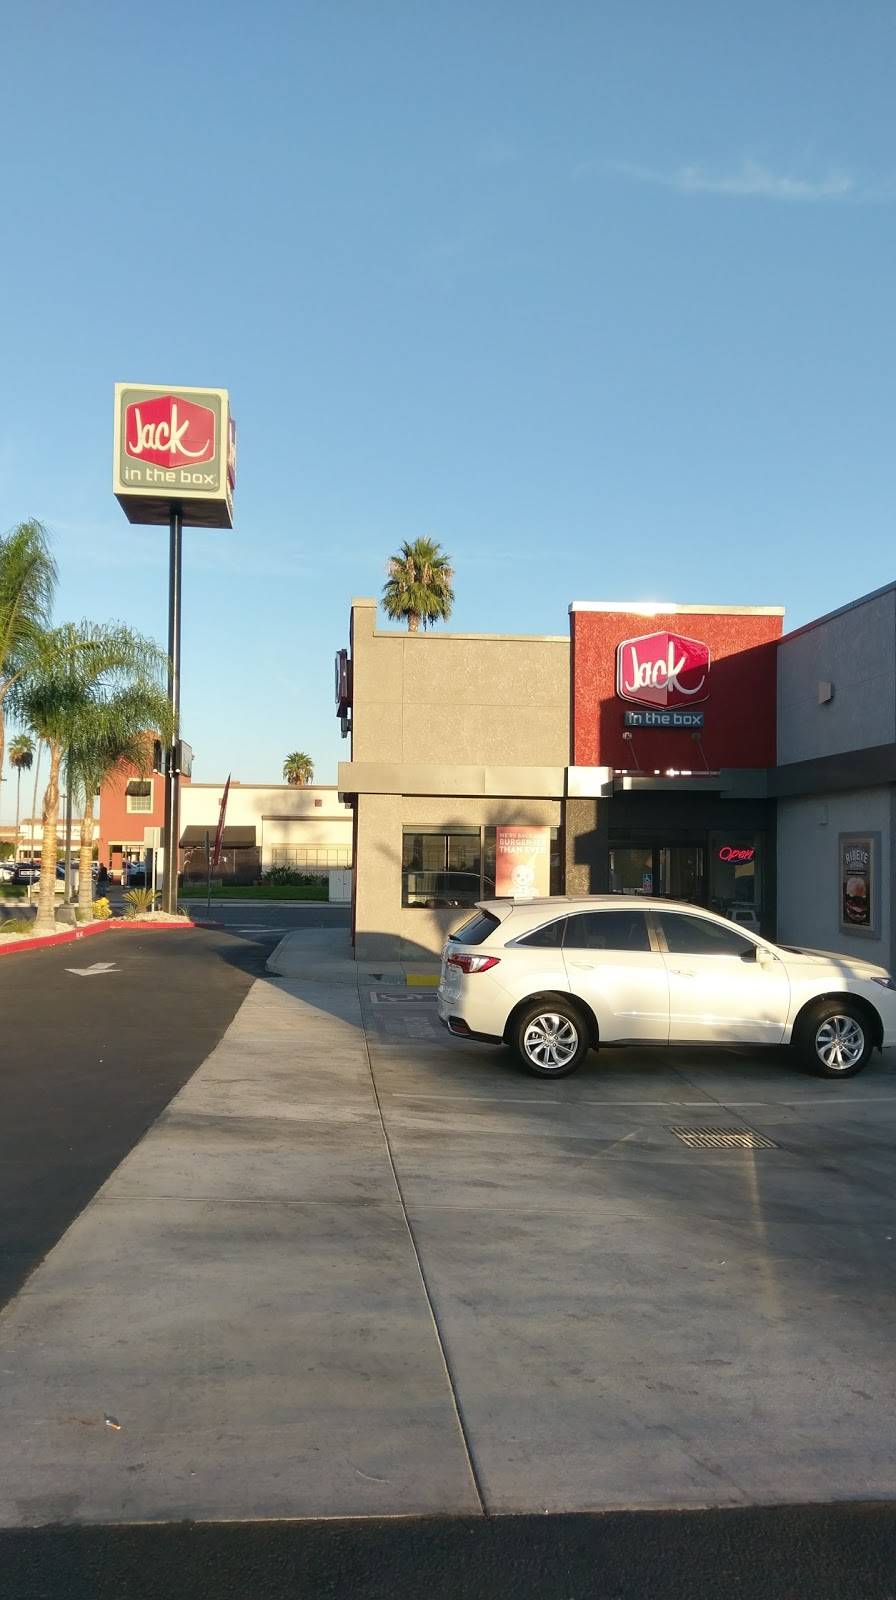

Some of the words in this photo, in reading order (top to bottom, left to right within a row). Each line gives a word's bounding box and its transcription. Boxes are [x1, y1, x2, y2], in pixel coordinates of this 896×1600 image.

[128, 404, 210, 457] Jack
[124, 467, 141, 481] in
[145, 468, 175, 482] the
[180, 470, 215, 485] box
[625, 641, 705, 695] Jack
[628, 712, 642, 724] in
[645, 712, 670, 724] the
[673, 712, 702, 725] box
[719, 846, 754, 862] Open
